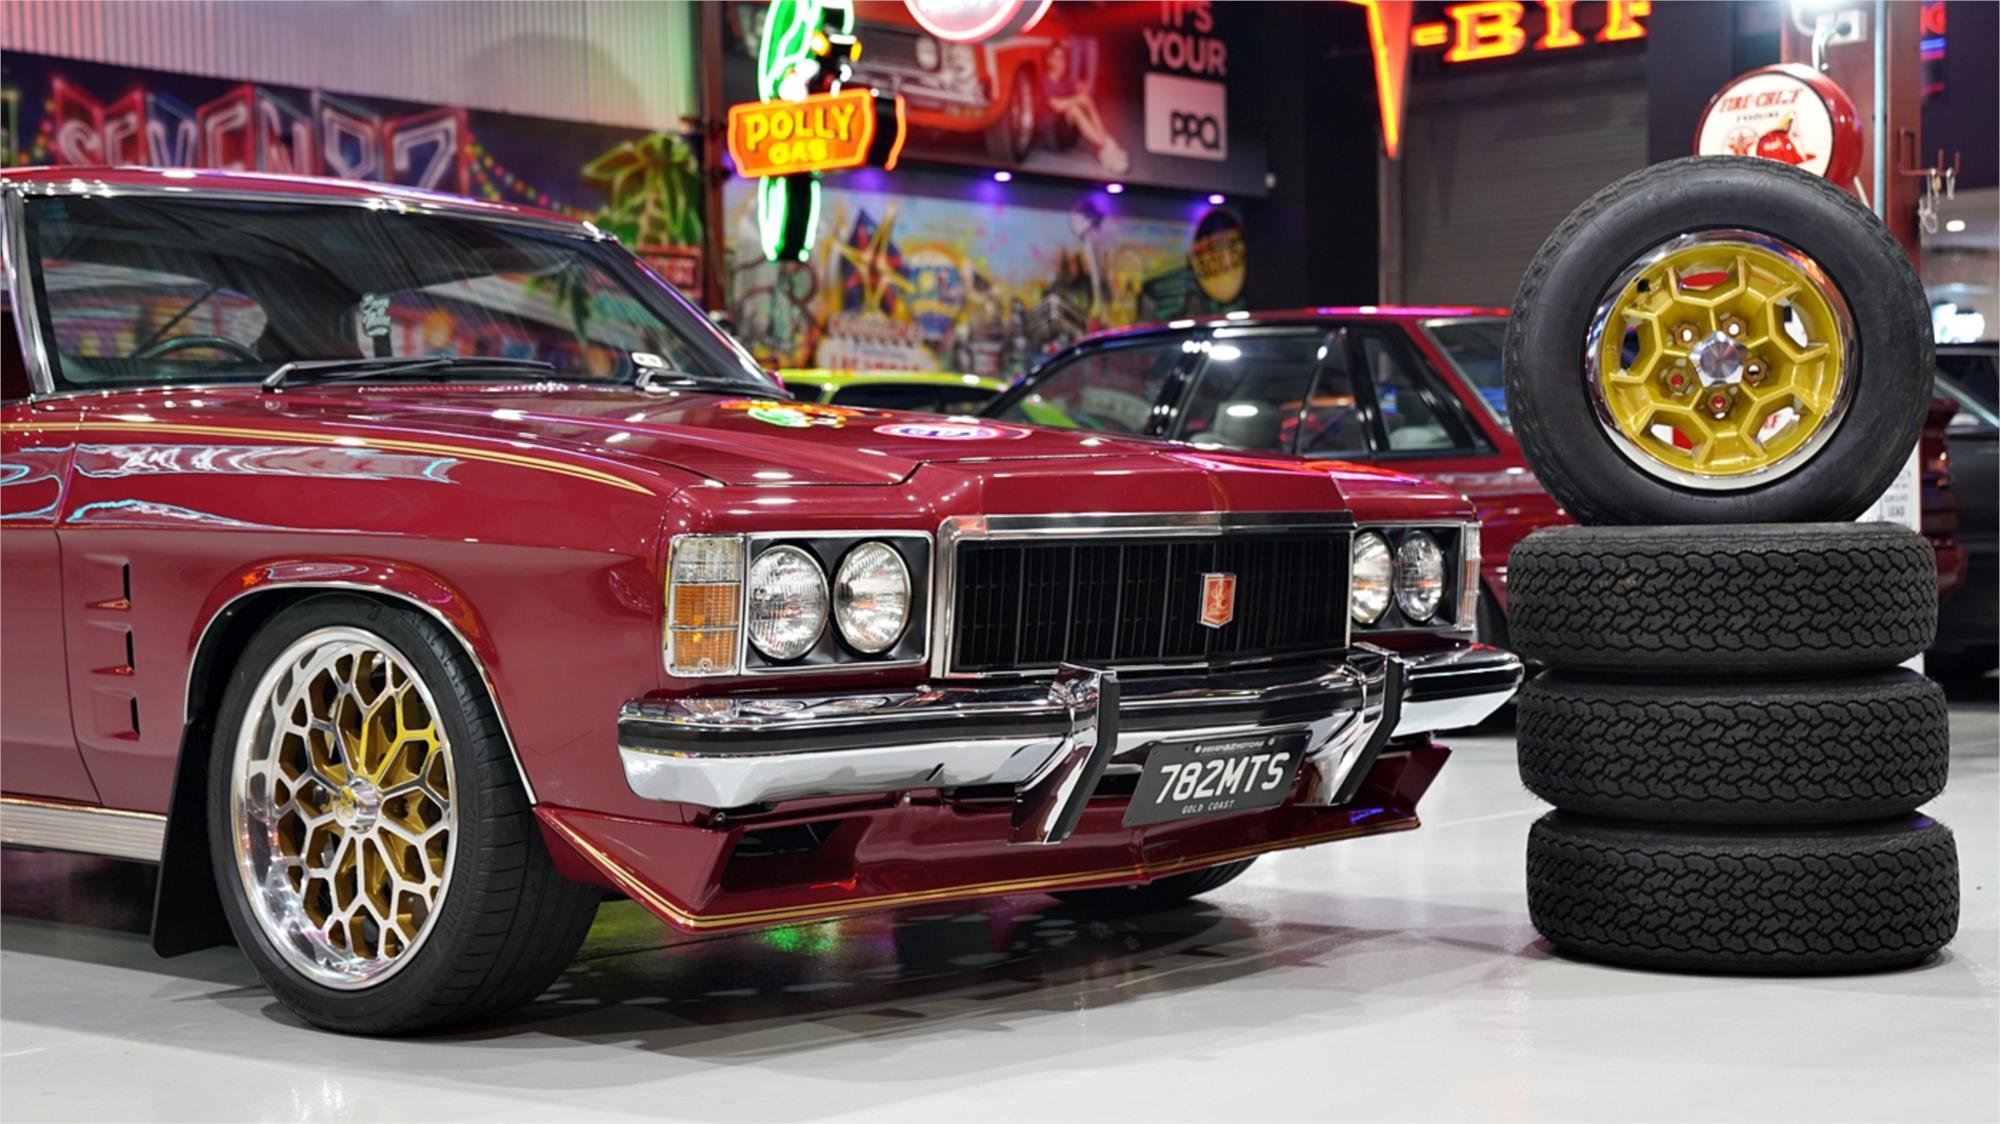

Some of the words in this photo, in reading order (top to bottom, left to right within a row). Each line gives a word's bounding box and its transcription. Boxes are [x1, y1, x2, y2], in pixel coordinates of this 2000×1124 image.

[1142, 26, 1228, 76] YOUR
[1720, 88, 1804, 113] FIRE-CHIF
[743, 103, 855, 151] POLLY
[1170, 110, 1221, 151] PPQ
[768, 138, 828, 166] GAS
[1155, 752, 1291, 804] 782MTS
[1181, 803, 1204, 815] GOLD
[1207, 799, 1236, 812] COAST
